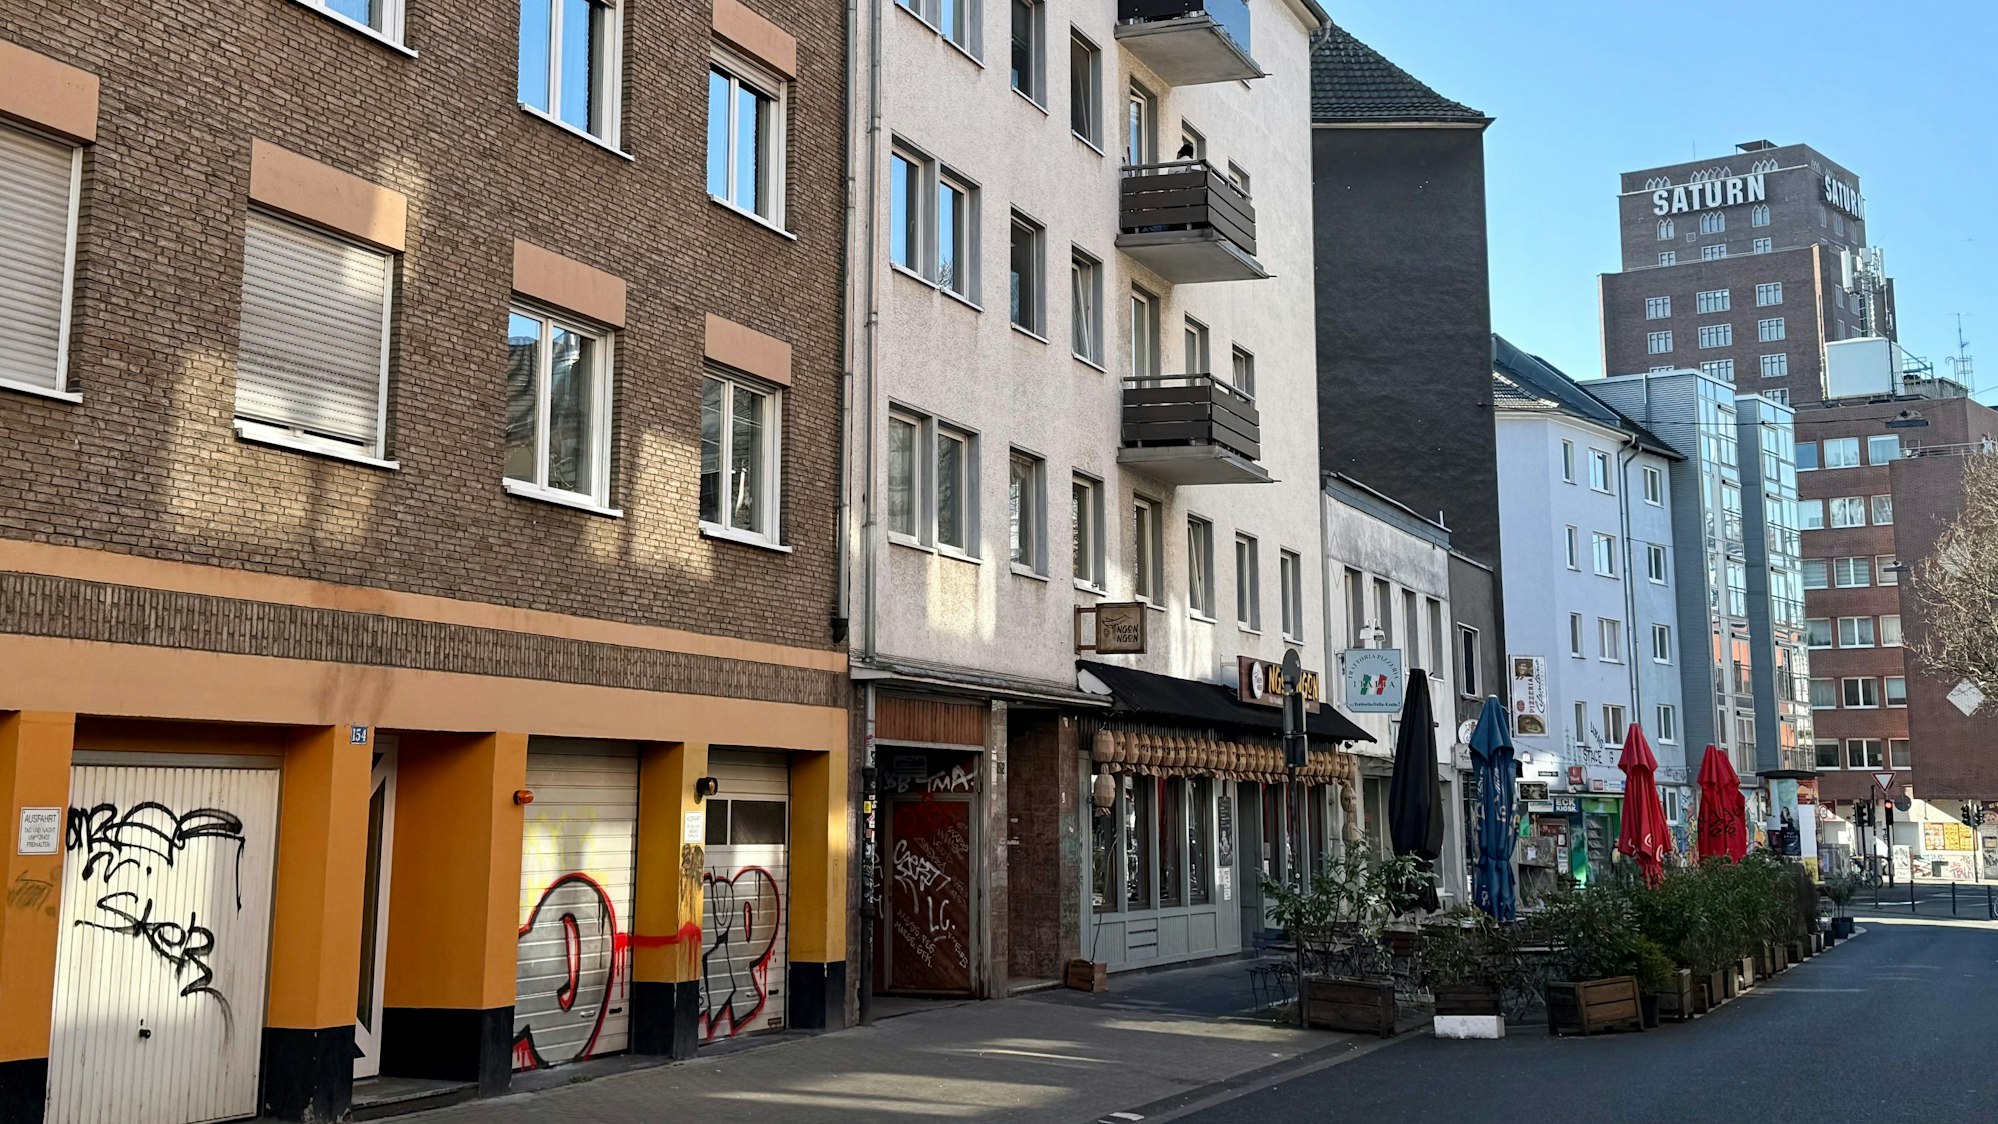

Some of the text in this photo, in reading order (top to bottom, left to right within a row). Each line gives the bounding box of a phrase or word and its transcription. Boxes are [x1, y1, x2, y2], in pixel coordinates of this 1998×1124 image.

[1653, 175, 1765, 216] SATURN
[1353, 680, 1395, 688] ITALIA
[1528, 677, 1536, 714] PIZZERIA
[352, 727, 367, 742] 154
[1554, 798, 1577, 806] ECK
[25, 814, 57, 824] AUSFAHRT
